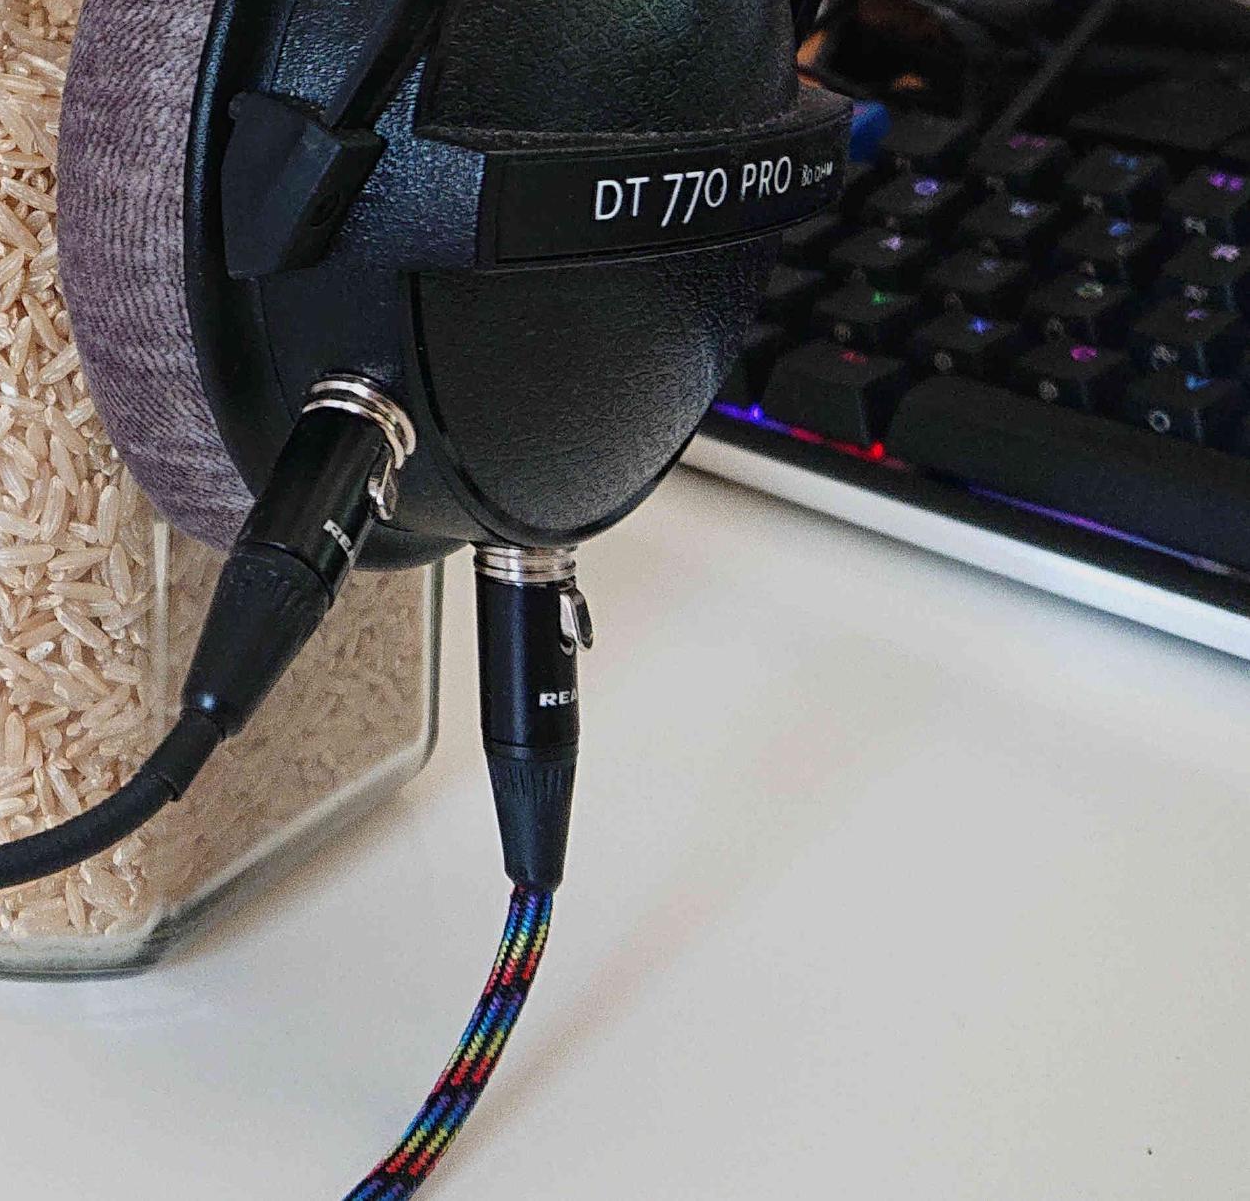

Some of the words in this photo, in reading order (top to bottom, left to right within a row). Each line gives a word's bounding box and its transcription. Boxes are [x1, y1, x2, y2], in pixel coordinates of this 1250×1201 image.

[594, 176, 650, 221] DT
[661, 167, 728, 228] 770
[741, 155, 792, 201] PRO
